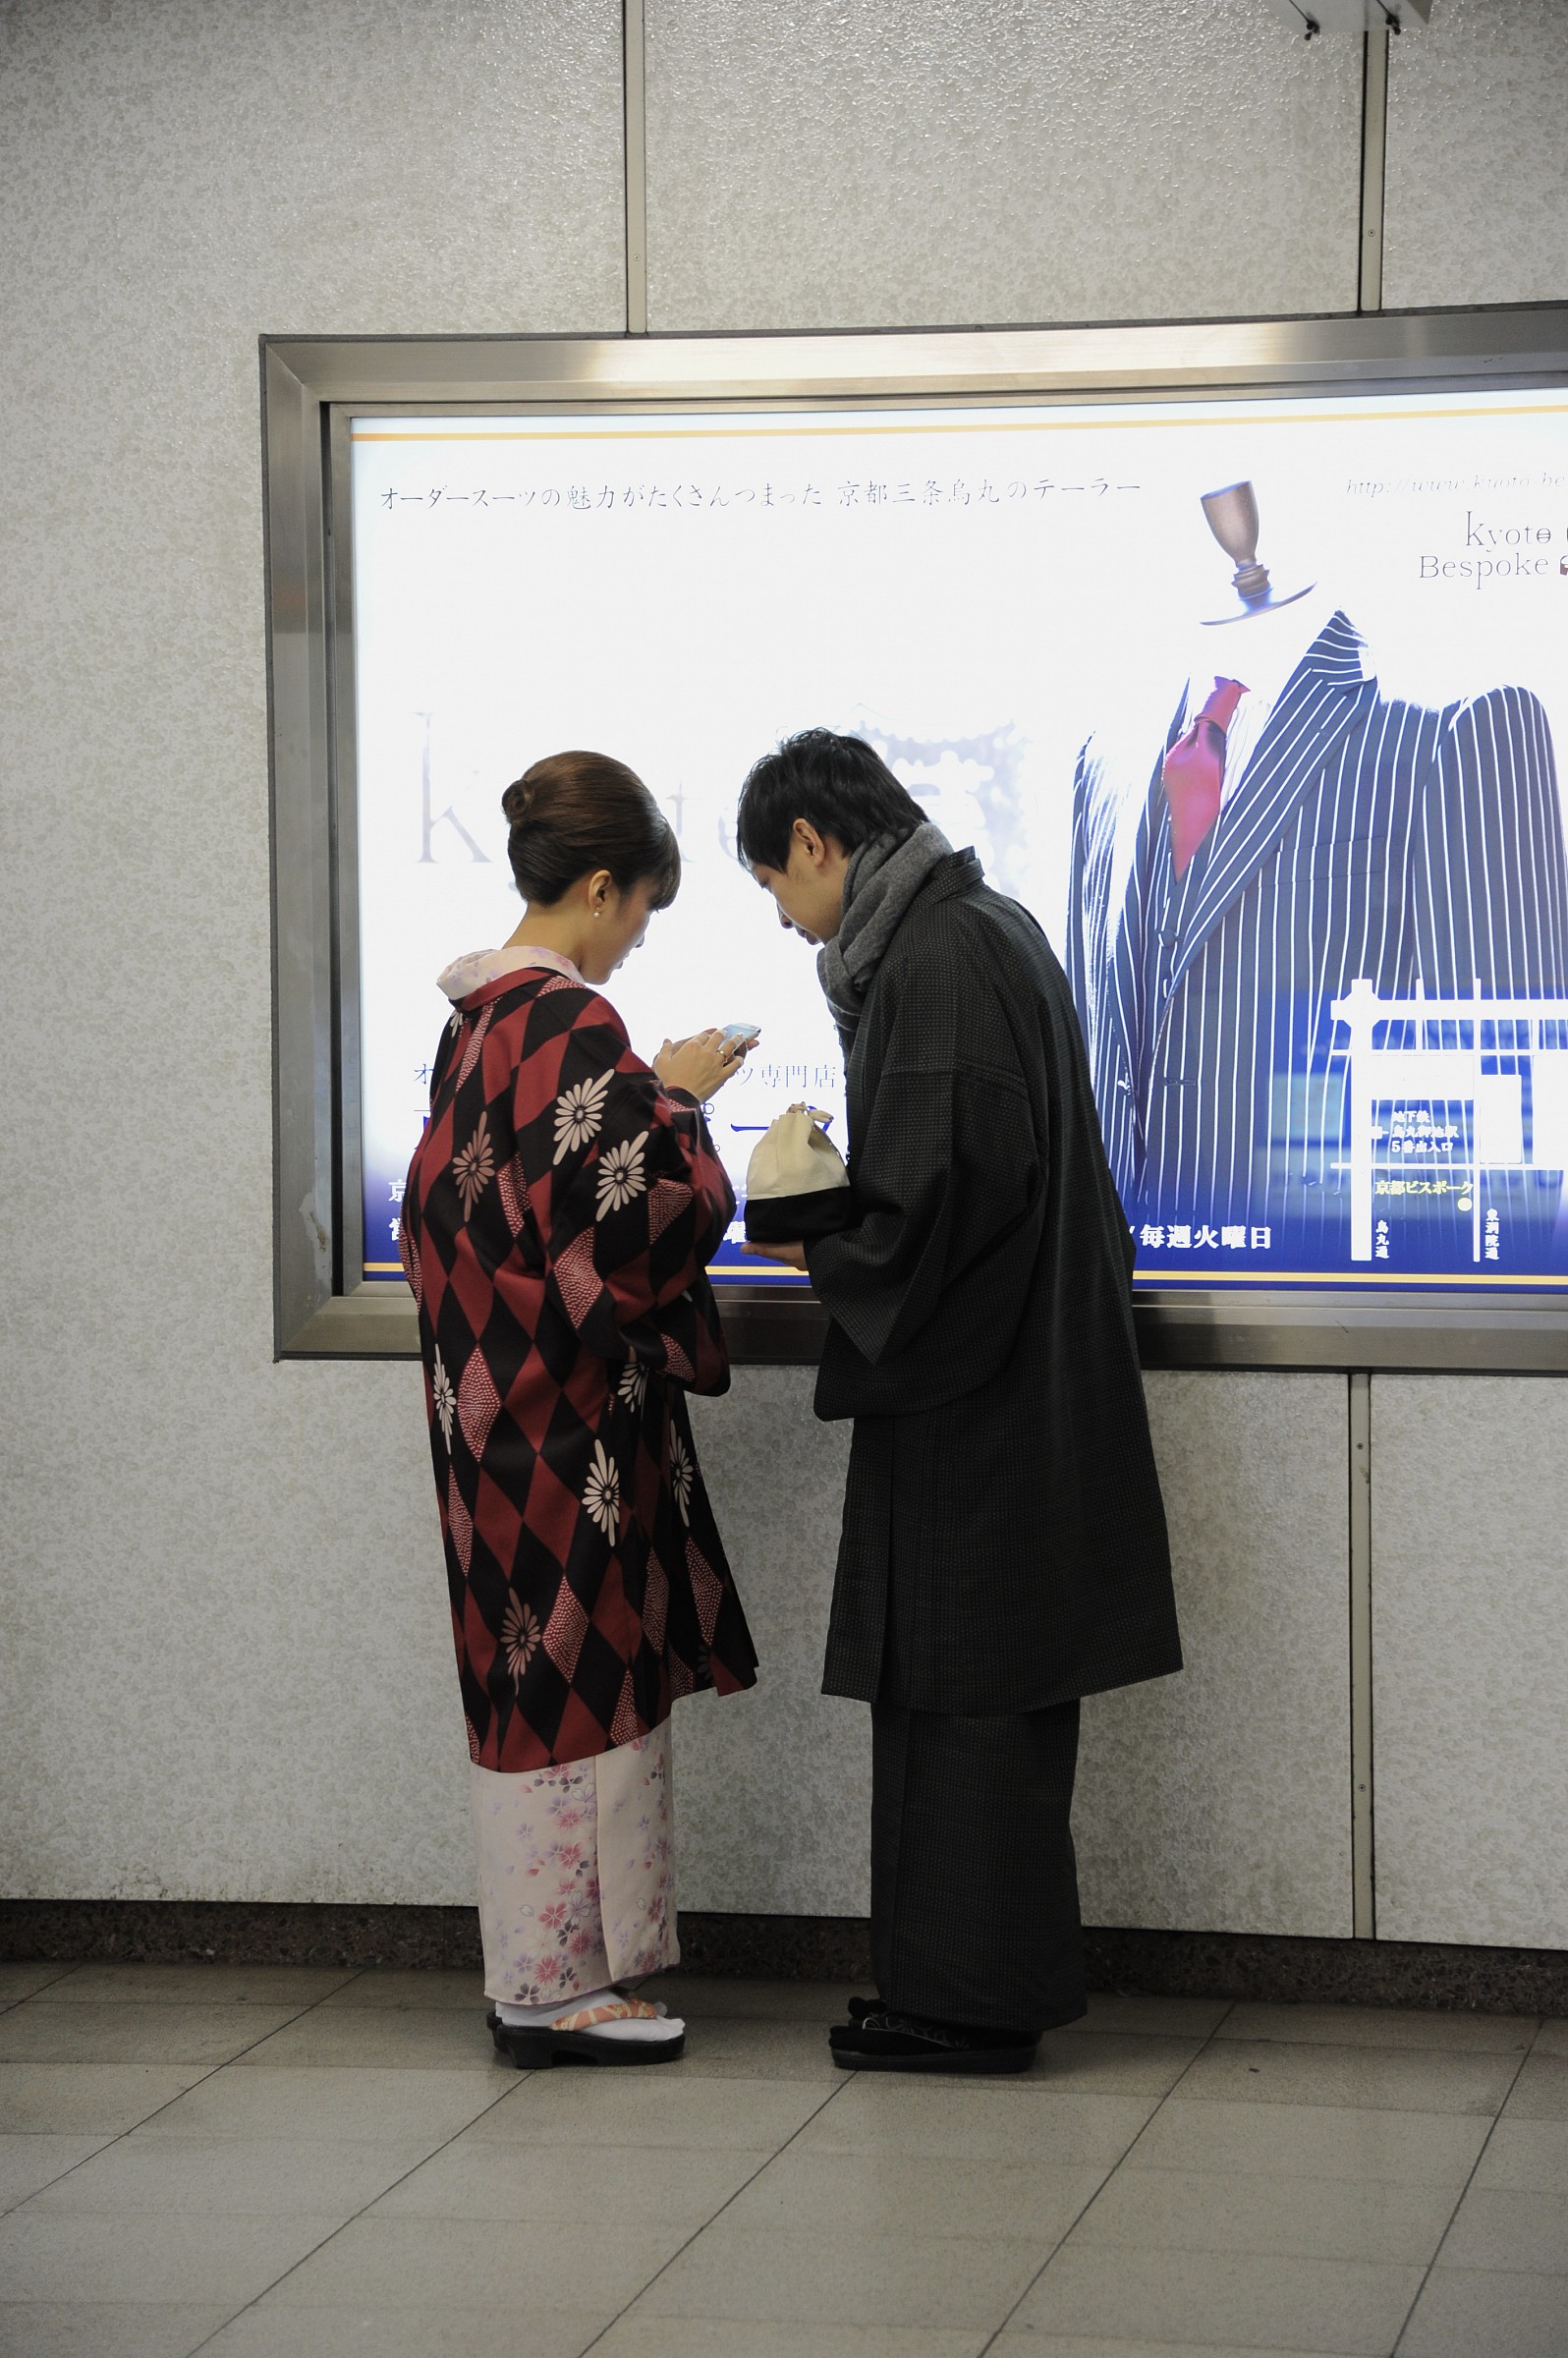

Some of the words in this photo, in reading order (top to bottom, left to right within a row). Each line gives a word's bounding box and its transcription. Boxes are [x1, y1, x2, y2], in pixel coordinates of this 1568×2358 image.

[379, 482, 821, 510] オーダースーツの魅力がたくさんつまった
[1419, 552, 1549, 590] Bespoke
[1375, 1181, 1473, 1195] 京都ビスポーク
[1140, 1224, 1271, 1249] 毎週火曜日
